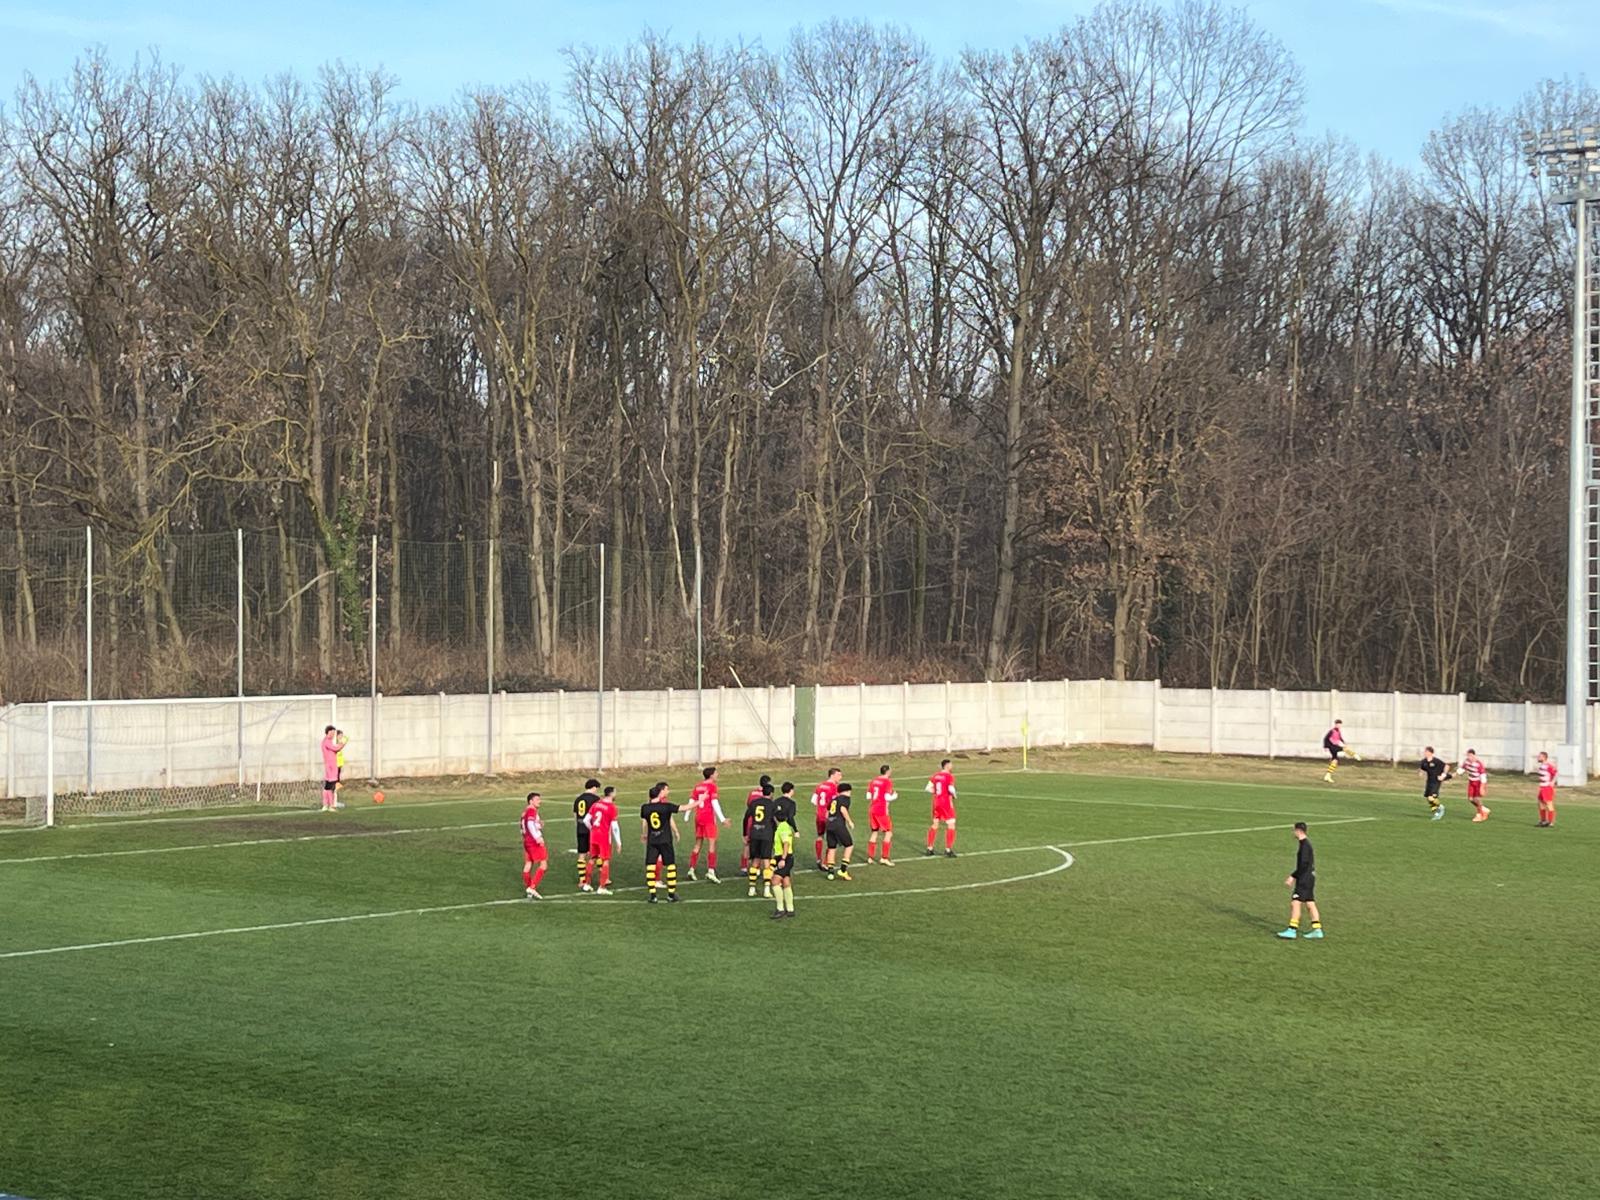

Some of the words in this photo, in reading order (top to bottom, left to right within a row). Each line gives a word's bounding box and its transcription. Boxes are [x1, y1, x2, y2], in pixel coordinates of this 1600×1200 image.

[578, 800, 586, 817] 9
[755, 805, 765, 822] 5
[594, 810, 602, 826] 2
[650, 812, 661, 829] 6
